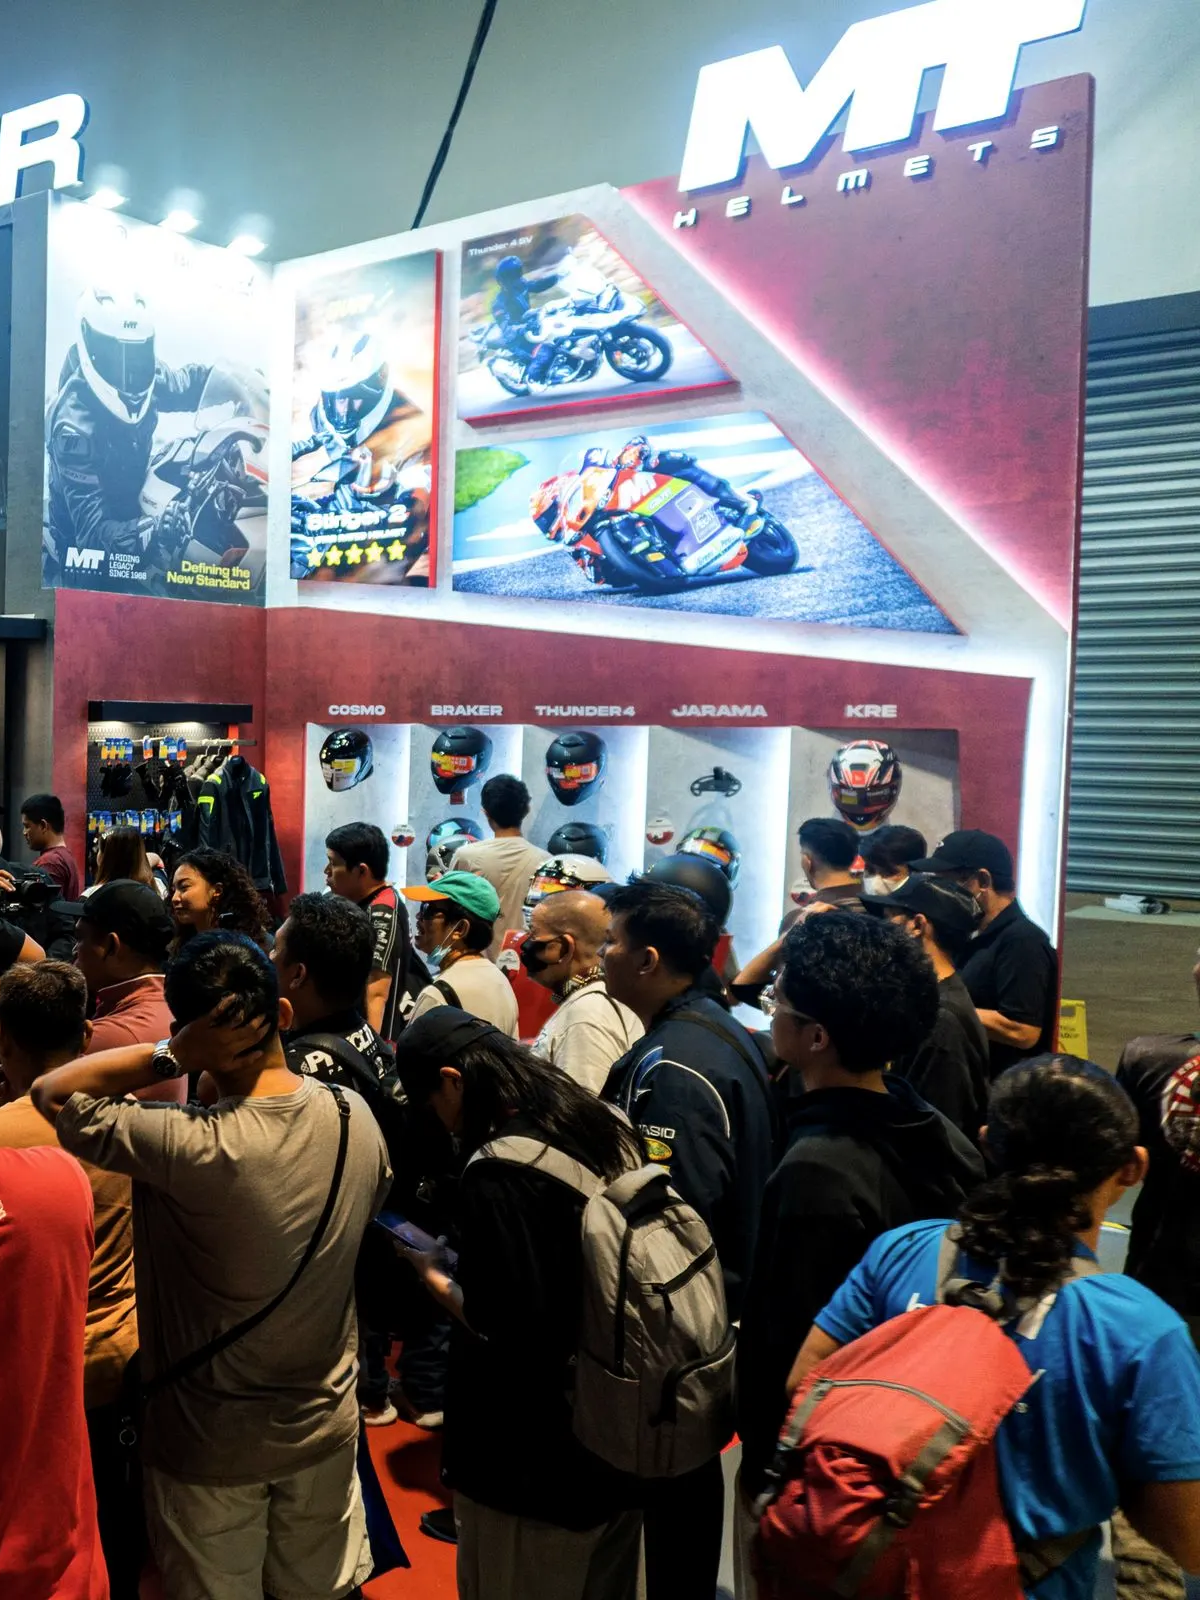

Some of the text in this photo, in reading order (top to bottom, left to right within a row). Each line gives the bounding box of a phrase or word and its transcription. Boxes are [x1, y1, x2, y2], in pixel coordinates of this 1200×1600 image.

[678, 0, 1087, 193] MT
[672, 126, 1059, 229] HELMETS
[468, 243, 508, 256] Thunder
[388, 504, 407, 524] 2
[65, 546, 105, 570] MT
[115, 554, 140, 564] RIDING
[109, 561, 134, 571] LEGACY
[182, 560, 250, 579] Defining the
[109, 569, 130, 579] SINCE
[167, 571, 250, 590] New Standard
[328, 704, 386, 717] COSMO
[431, 704, 503, 717] BRAKER
[671, 704, 768, 718] JARAMA
[845, 704, 898, 718] KRE
[639, 1124, 676, 1139] ASIO
